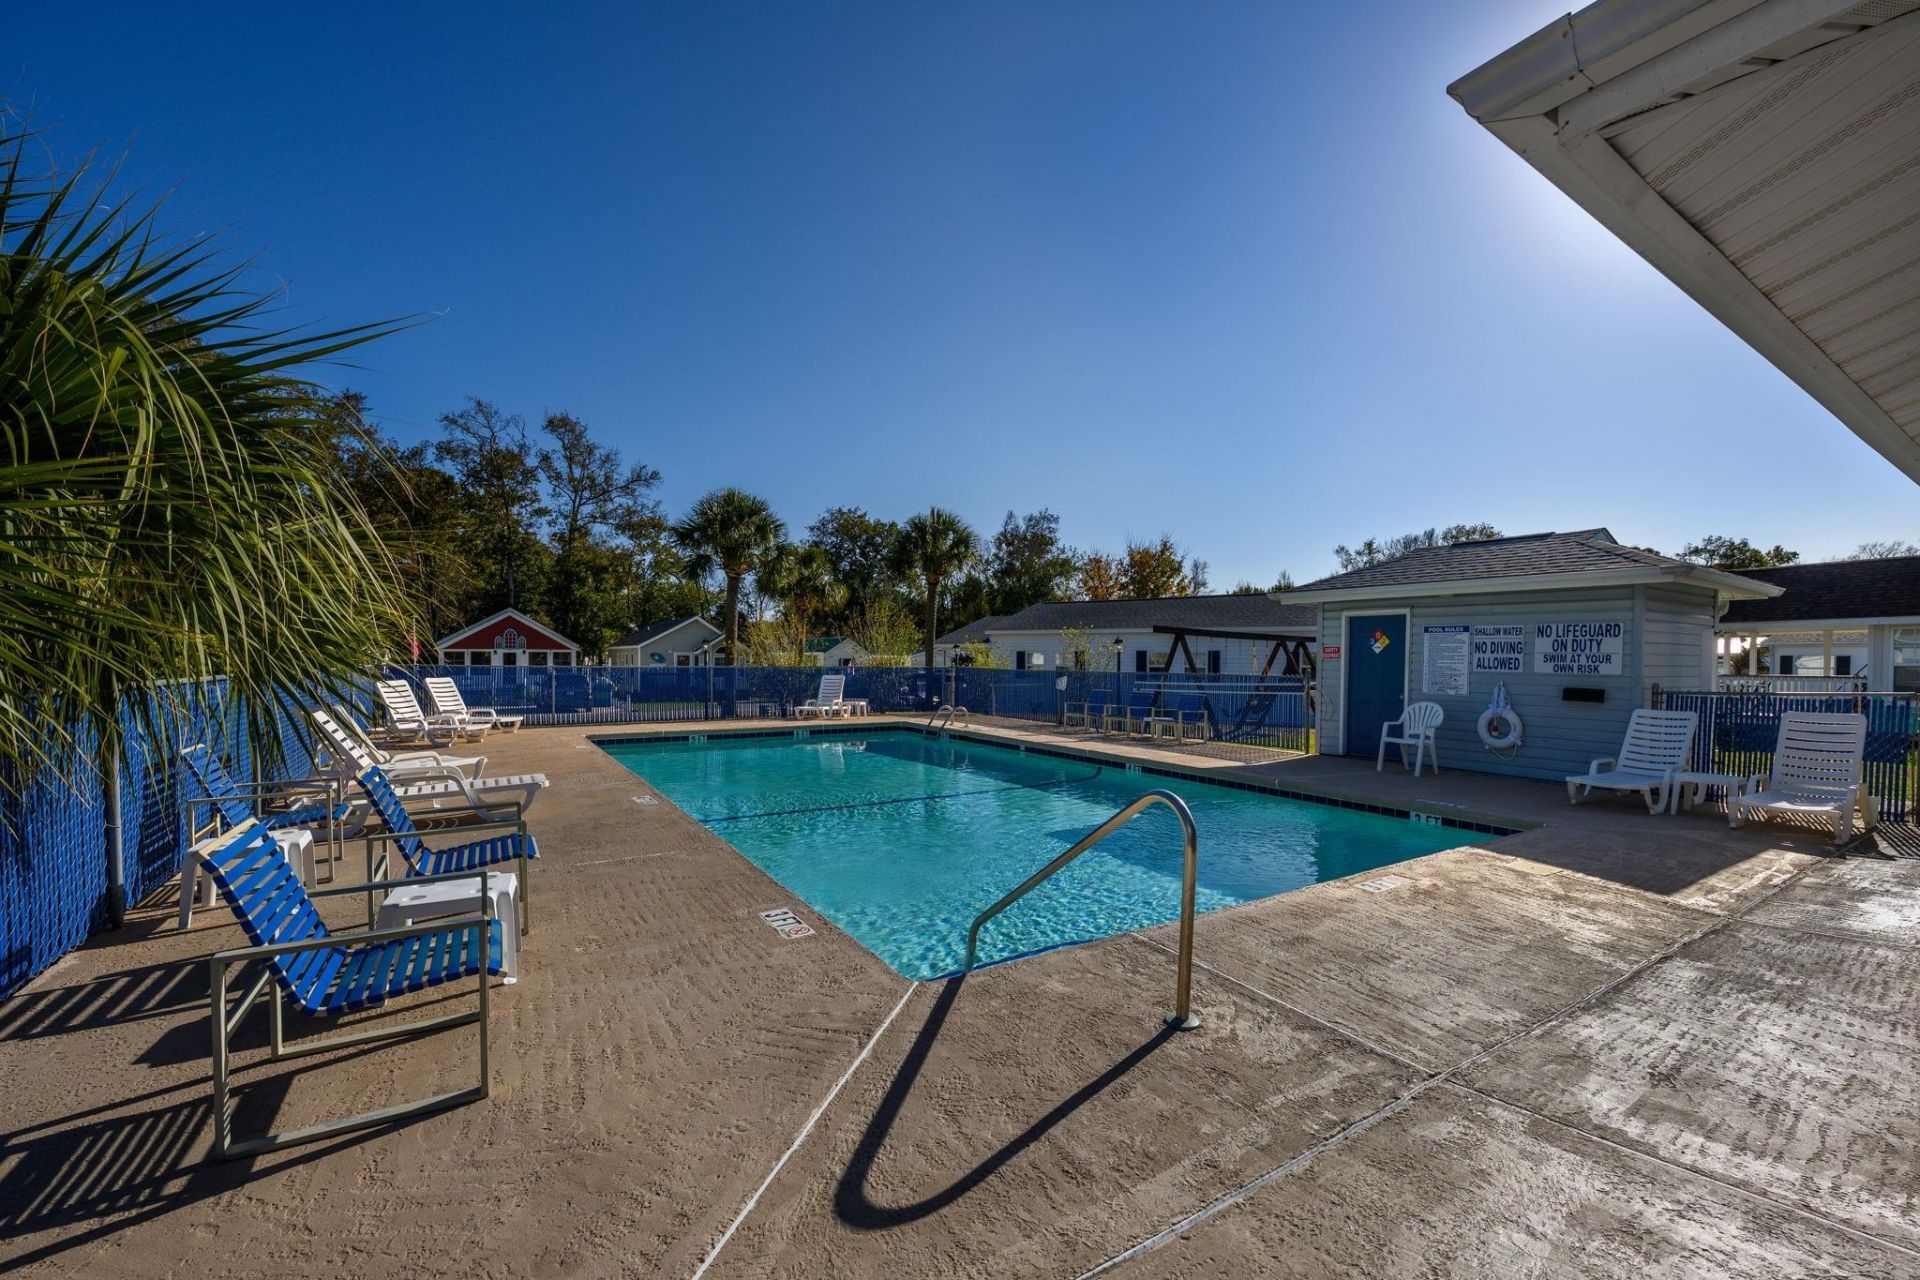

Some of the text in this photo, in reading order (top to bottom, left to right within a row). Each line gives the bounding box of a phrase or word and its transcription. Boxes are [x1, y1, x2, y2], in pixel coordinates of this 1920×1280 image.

[1474, 626, 1523, 636] SHALLOW WATER
[1537, 623, 1621, 638] NO LIFEGUARD
[1475, 641, 1523, 654] NO DIVING
[1552, 639, 1603, 652] ON DUTY
[1476, 656, 1520, 670] ALLOWED
[1543, 654, 1612, 664] SWIM AT YOUR
[1553, 664, 1600, 674] OWN RISK
[770, 916, 803, 928] FT
